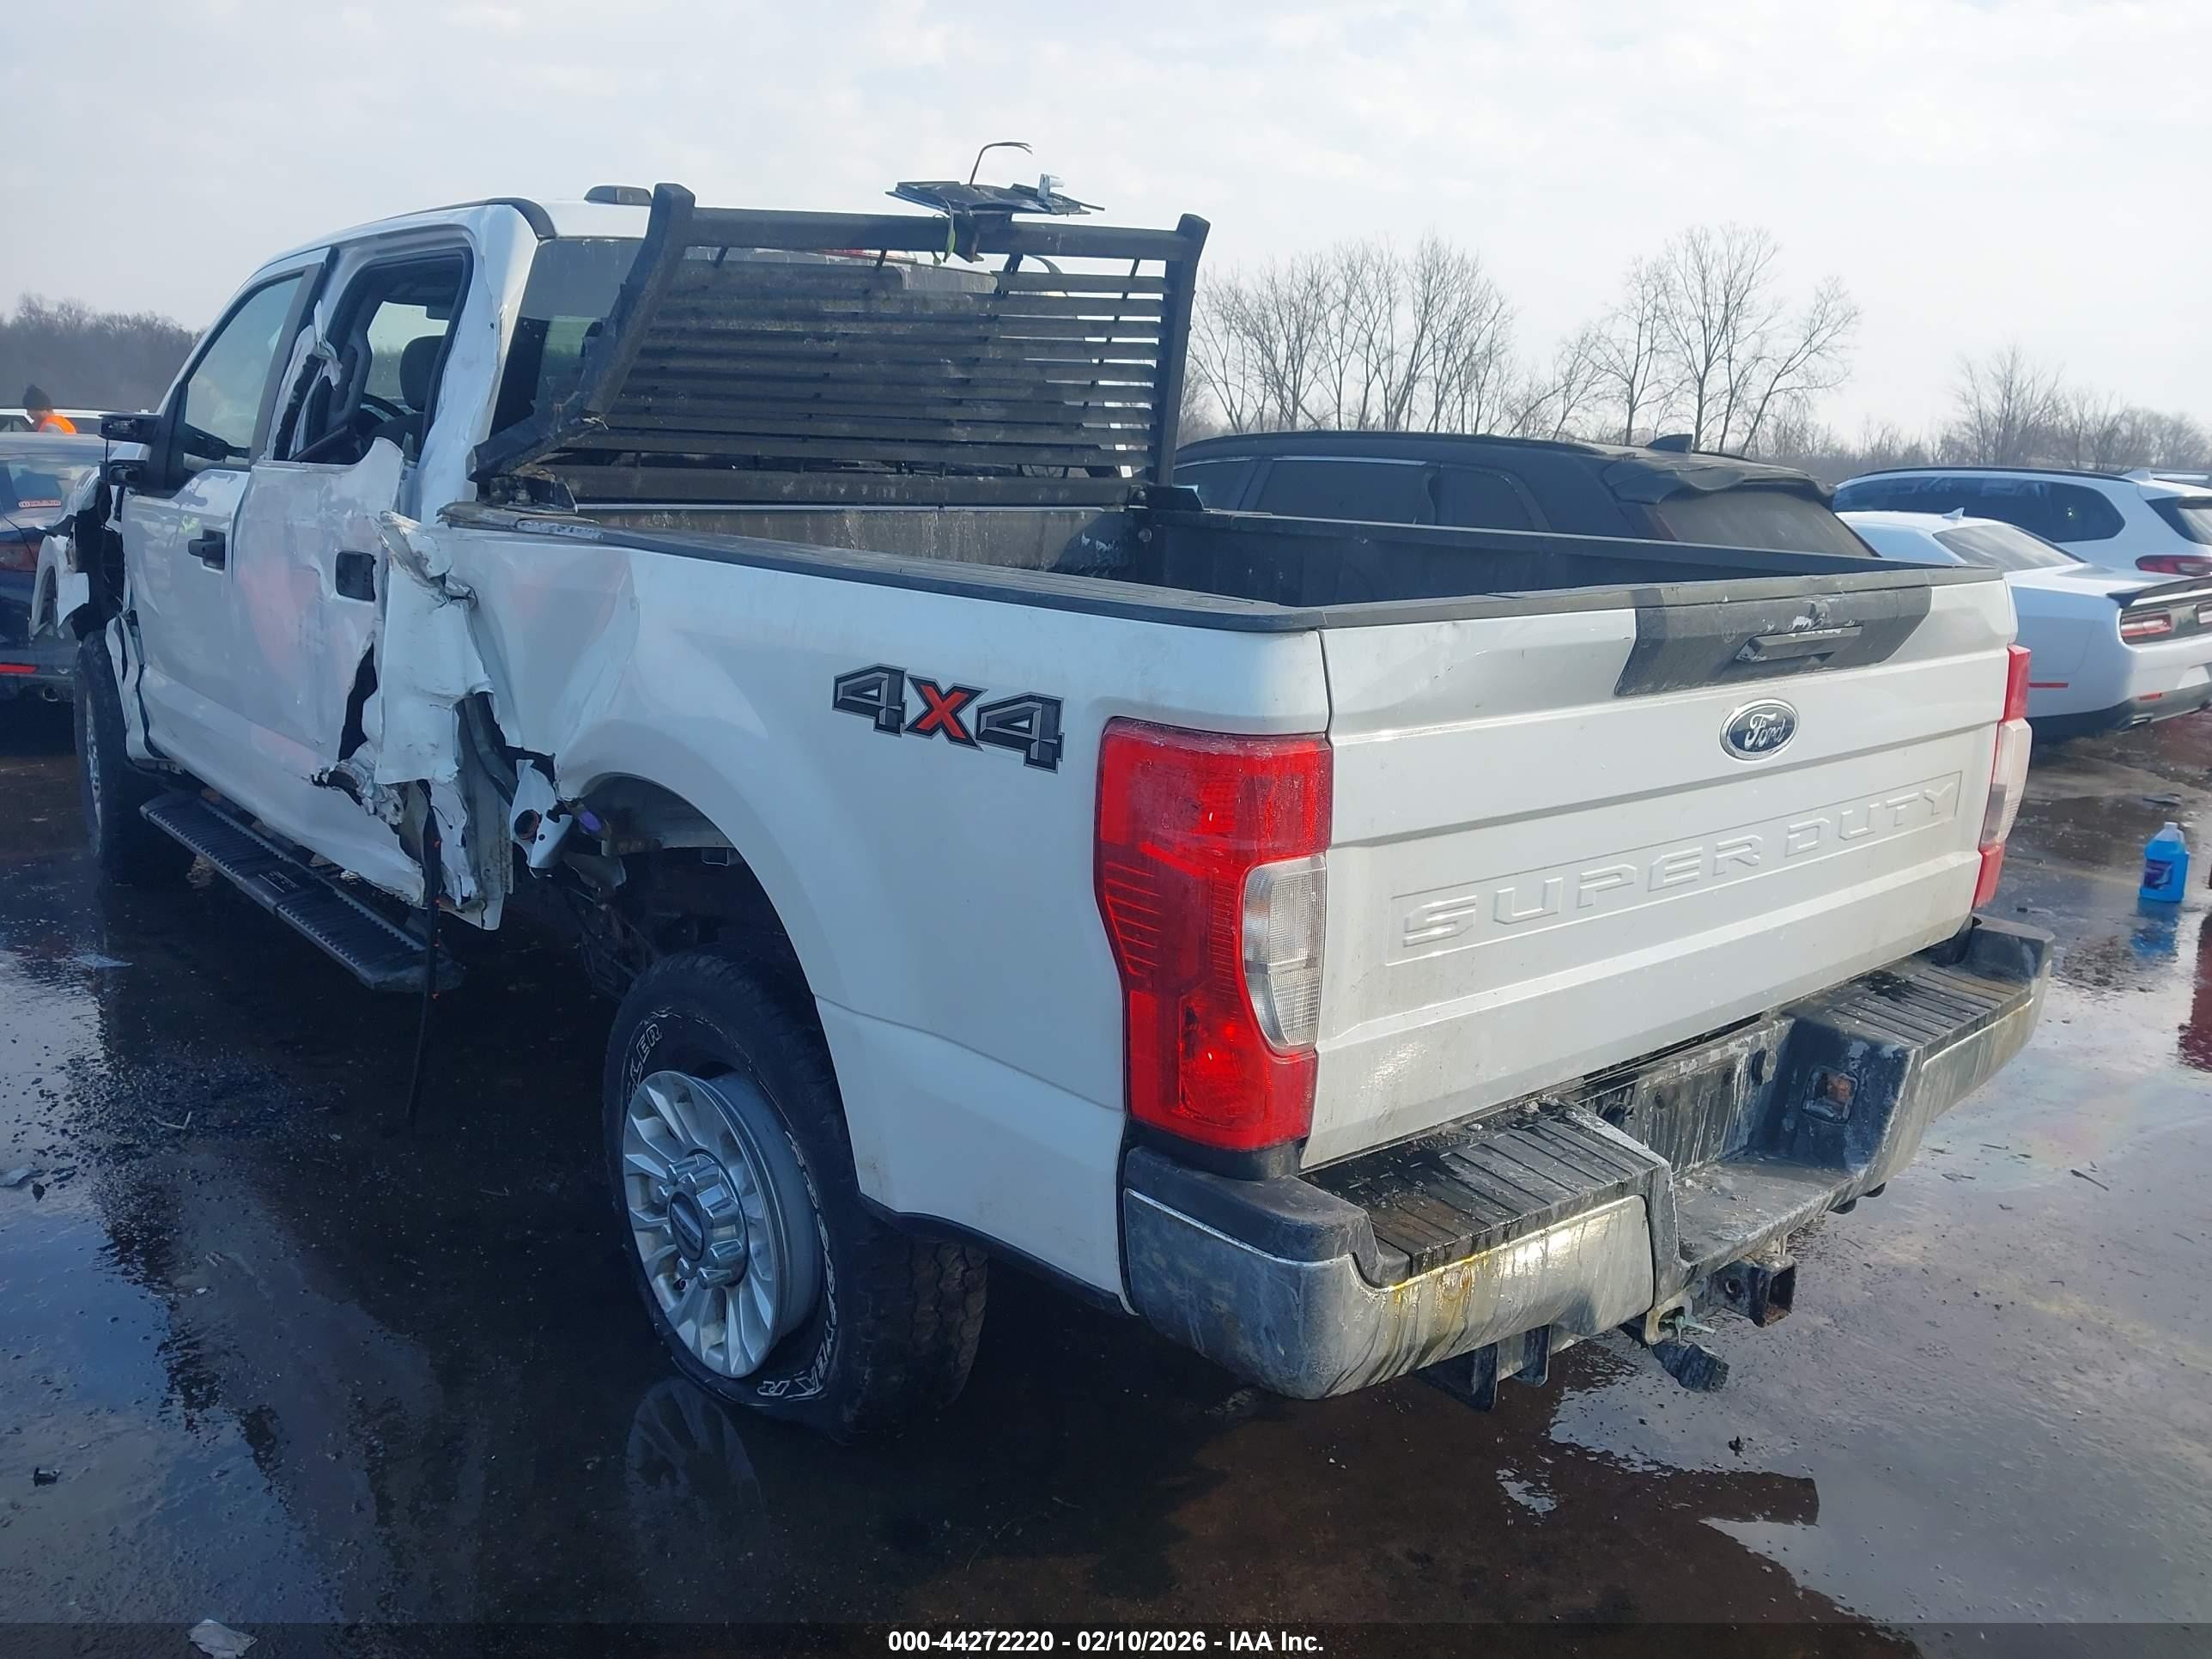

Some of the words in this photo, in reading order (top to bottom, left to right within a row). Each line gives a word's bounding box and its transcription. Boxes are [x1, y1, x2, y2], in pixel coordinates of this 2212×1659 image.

[1743, 712, 1786, 750] Ford
[1402, 833, 1762, 947] SUPER
[1784, 780, 1956, 860] DUTY
